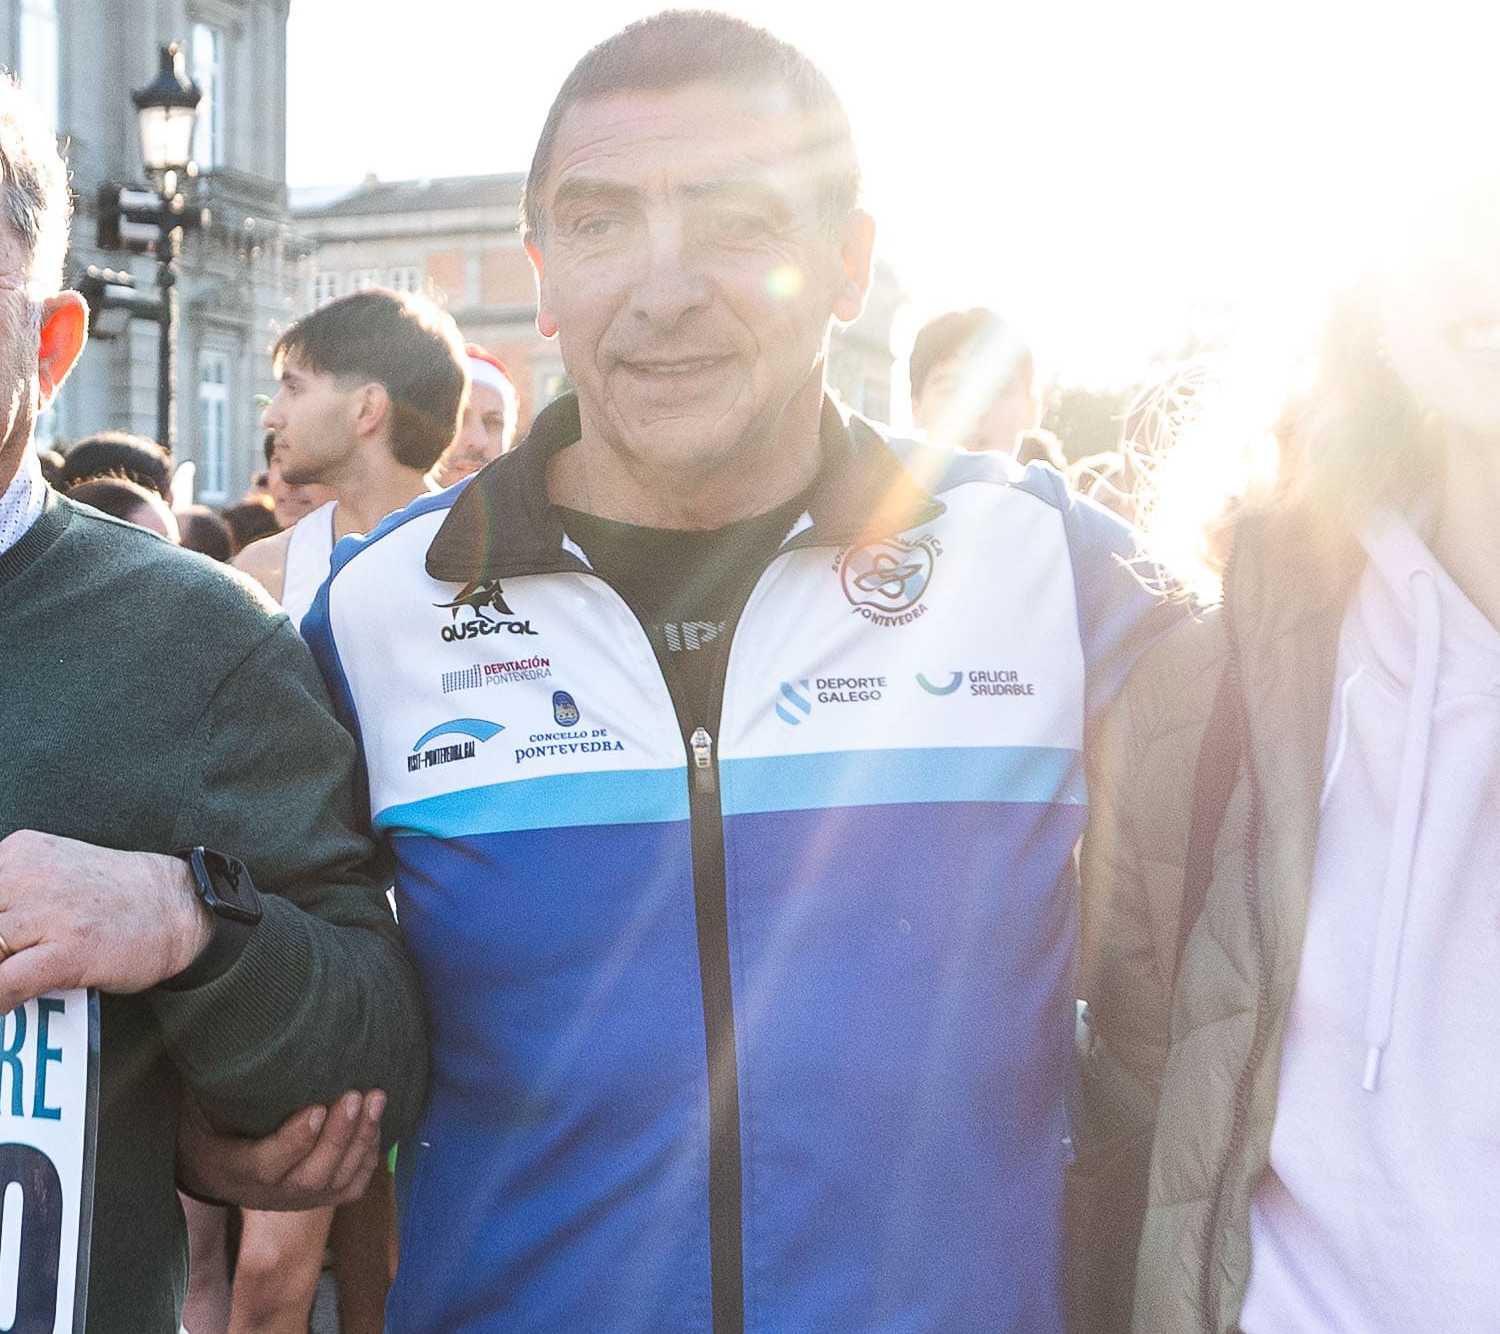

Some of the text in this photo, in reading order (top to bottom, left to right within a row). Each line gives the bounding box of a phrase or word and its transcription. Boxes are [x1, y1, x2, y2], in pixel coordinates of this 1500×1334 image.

[851, 603, 929, 627] PONTEVEDRA
[483, 654, 550, 676] DEPUTACIÓN
[485, 668, 553, 687] PONTEVEDRA
[816, 677, 888, 690] DEPORTE
[968, 670, 1019, 683] GALICIA
[818, 690, 882, 704] GALEGO
[970, 683, 1035, 697] SAUDABLE
[529, 728, 608, 743] CONCELLO DE
[515, 740, 625, 764] PONTEVEDRA
